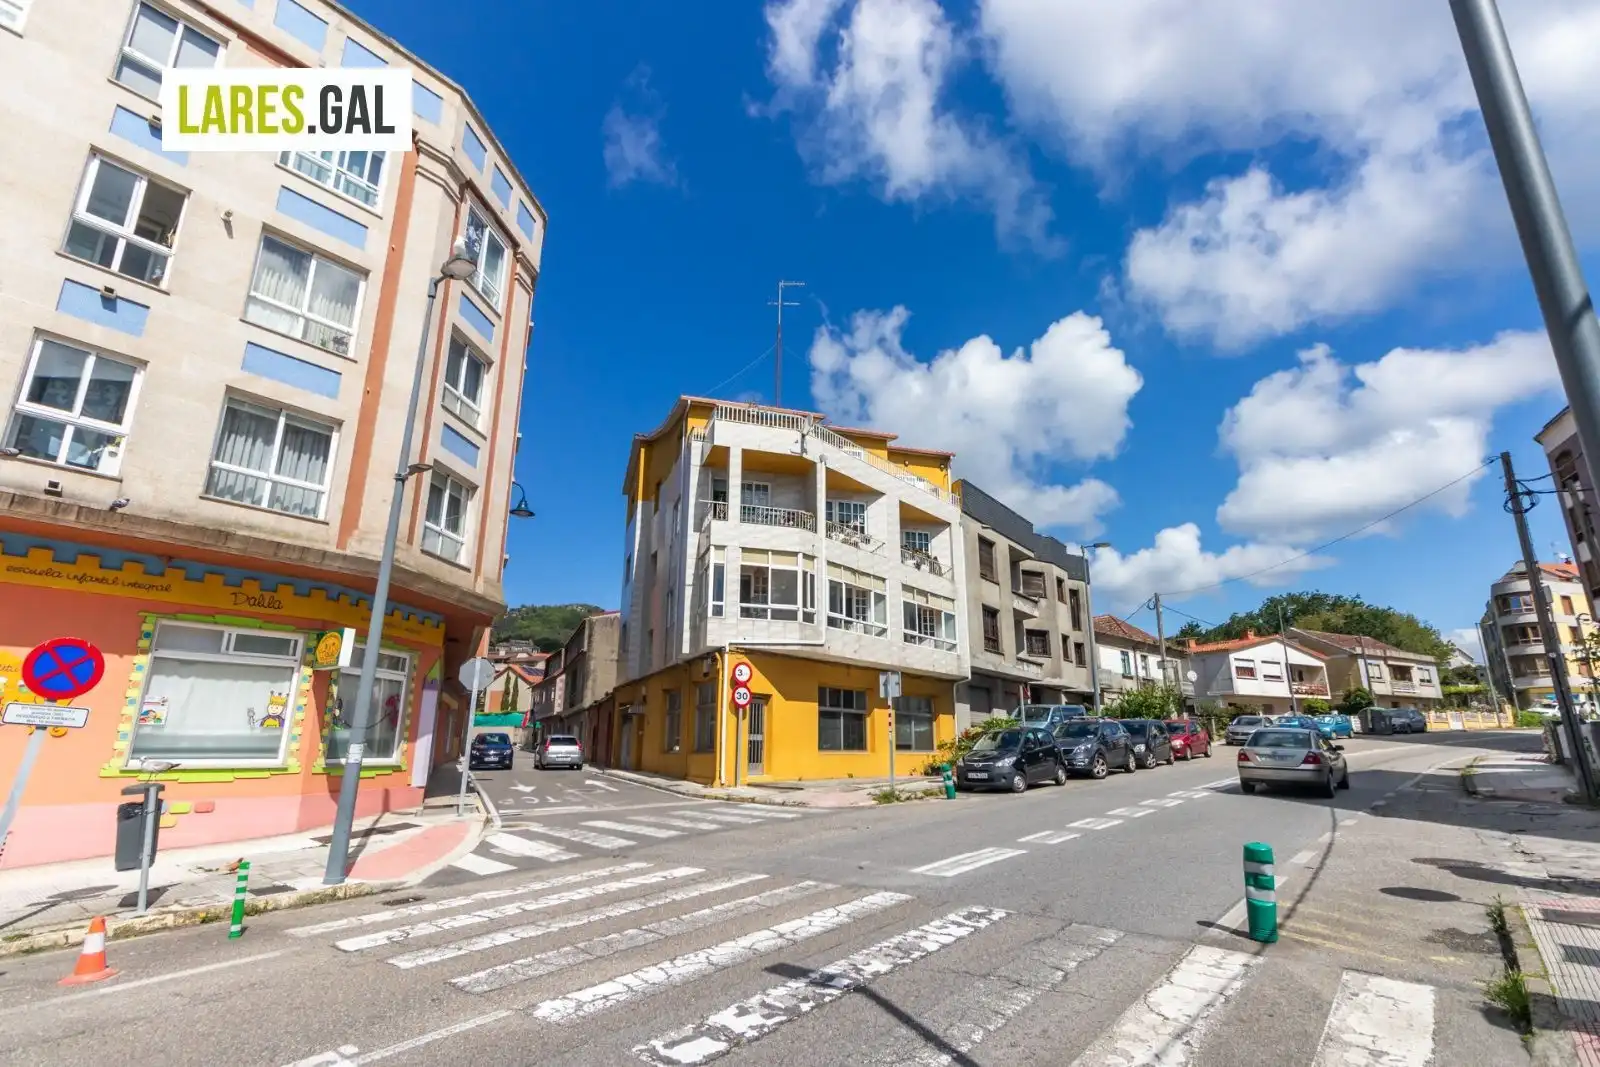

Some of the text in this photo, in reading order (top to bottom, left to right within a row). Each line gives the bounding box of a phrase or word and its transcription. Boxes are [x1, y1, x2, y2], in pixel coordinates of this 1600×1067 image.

[6, 563, 172, 593] escuela infantil integral
[230, 591, 284, 610] Dalila
[736, 691, 748, 701] 30
